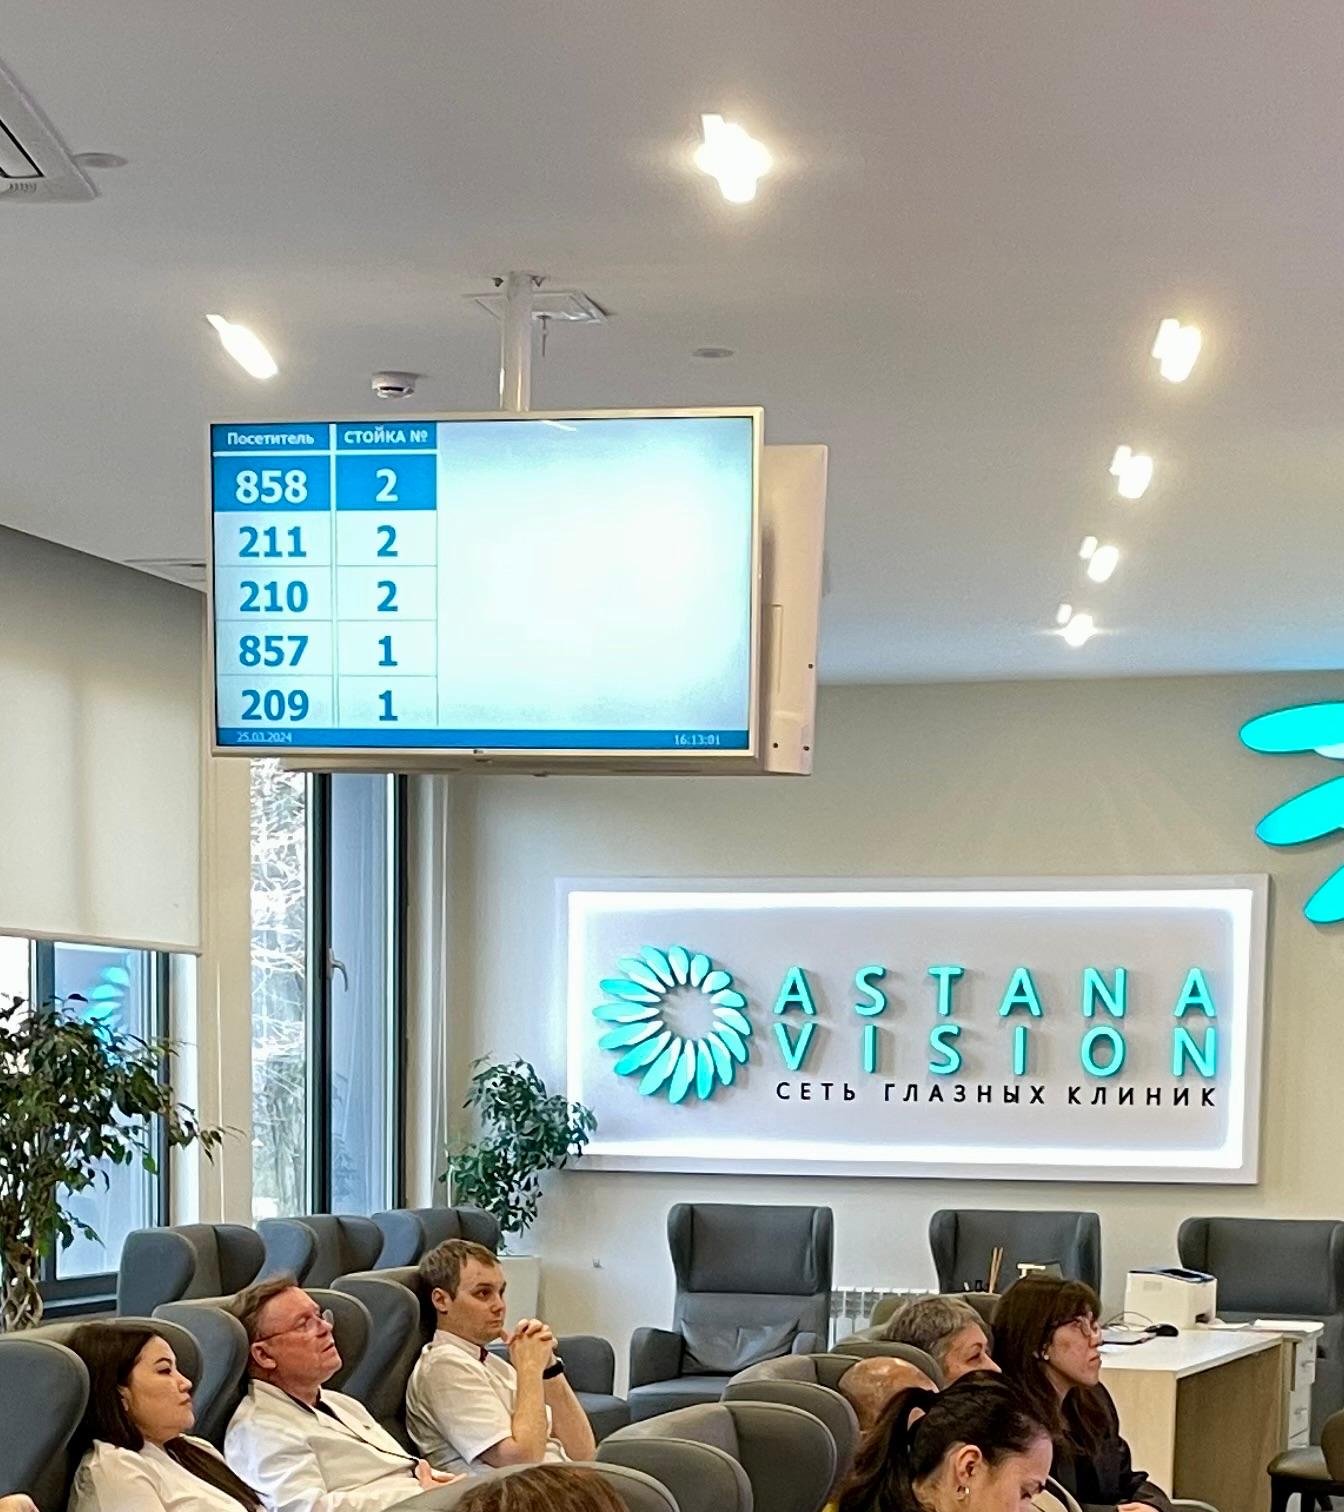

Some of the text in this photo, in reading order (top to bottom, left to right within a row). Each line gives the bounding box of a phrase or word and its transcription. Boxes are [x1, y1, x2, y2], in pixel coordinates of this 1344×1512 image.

[227, 432, 315, 446] Посетитель
[344, 426, 428, 444] СТОЙКА №
[235, 468, 399, 504] 858 2
[238, 525, 398, 559] 211 2
[239, 580, 398, 613] 210 2
[239, 635, 399, 668] 857 1
[241, 689, 399, 722] 209 1
[674, 734, 720, 745] 16:13:01
[773, 965, 1217, 1018] ASTANA
[773, 1022, 1217, 1078] VISION
[775, 1081, 1217, 1107] СЕТЬ ГЛАЗНЫХ КЛИНИК
